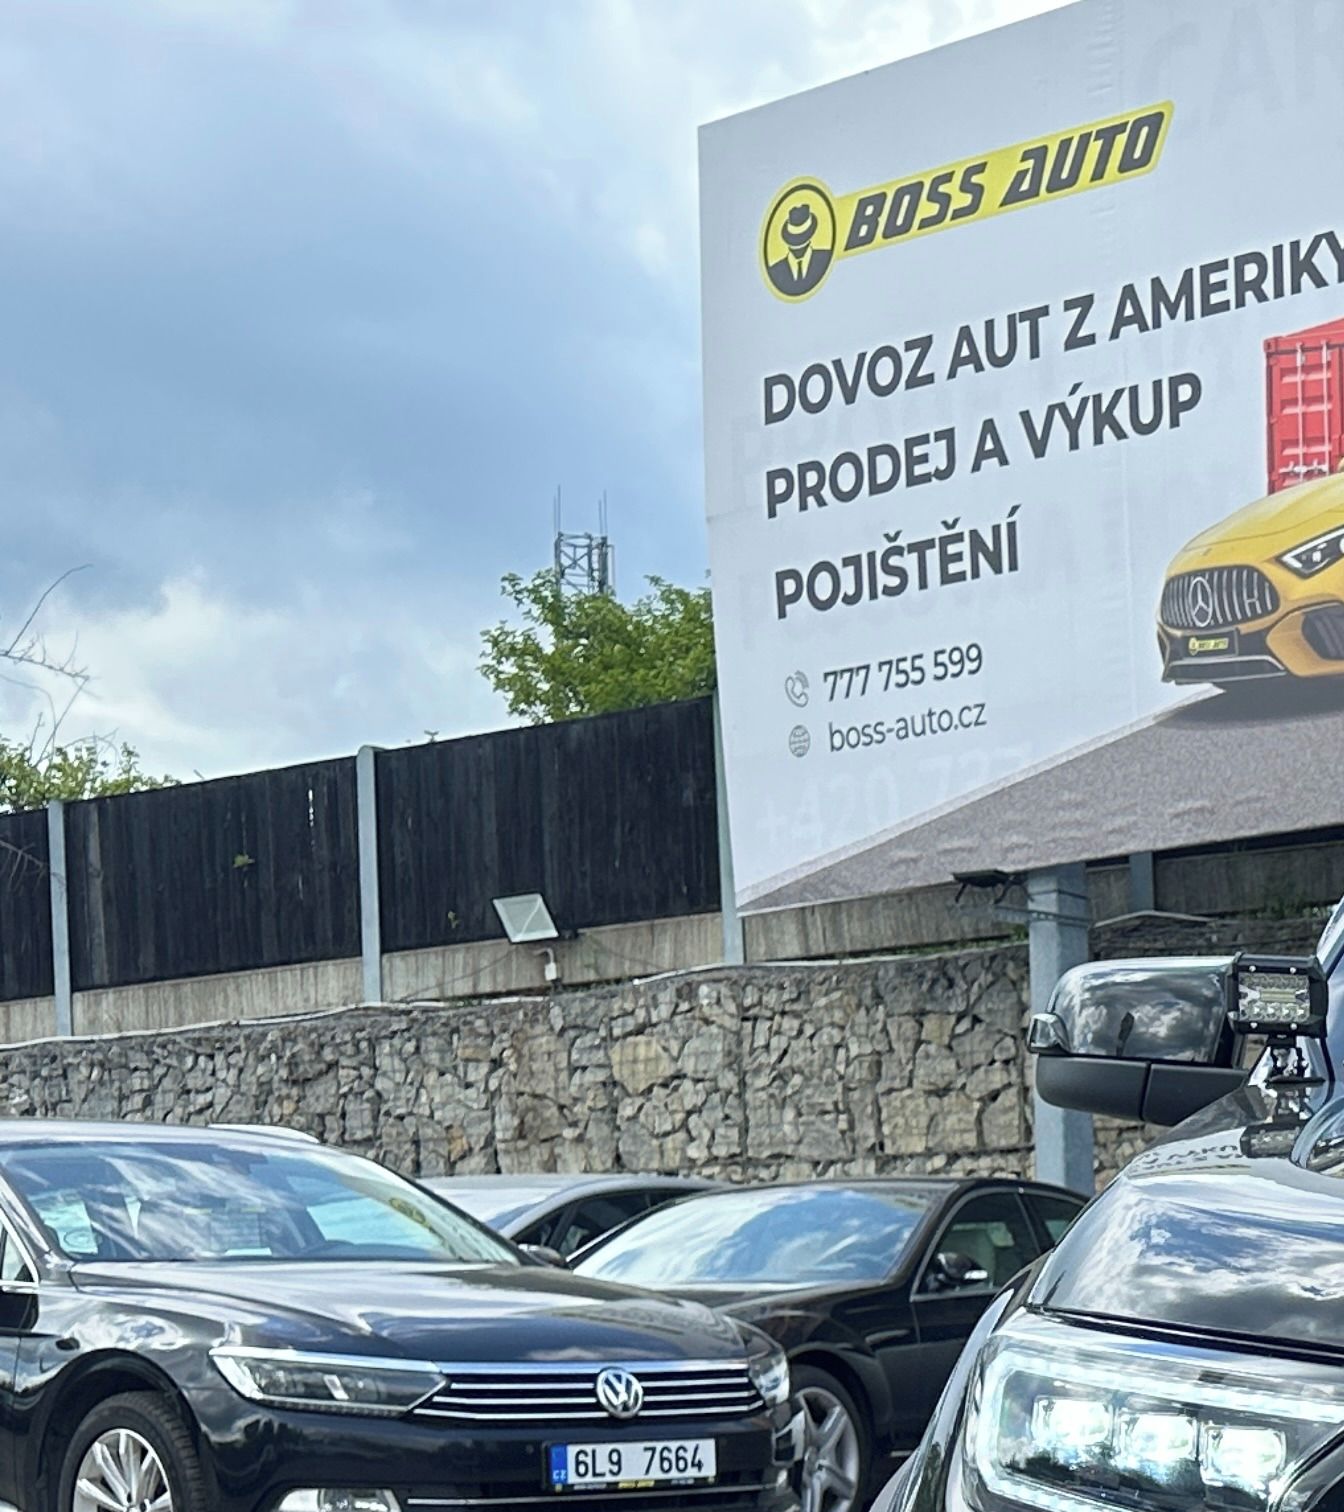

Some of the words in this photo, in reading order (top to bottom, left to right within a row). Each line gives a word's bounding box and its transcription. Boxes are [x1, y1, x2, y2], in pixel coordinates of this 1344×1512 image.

[844, 161, 988, 252] BOSS
[999, 110, 1165, 208] AUTO
[762, 334, 935, 425] DOVOZ
[947, 306, 1050, 381] AUT
[1064, 294, 1096, 348] Z
[765, 428, 957, 519] PRODEJ
[972, 417, 1009, 472] A
[1021, 372, 1202, 459] VÝKUP
[774, 505, 1022, 620] POJIŠTĚNÍ
[823, 664, 870, 702] 777
[878, 654, 927, 693] 755
[933, 644, 983, 683] 599
[828, 701, 987, 752] boss-auto.cz
[553, 1470, 567, 1480] CZ
[575, 1448, 622, 1478] 6L9
[643, 1443, 704, 1475] 7664
